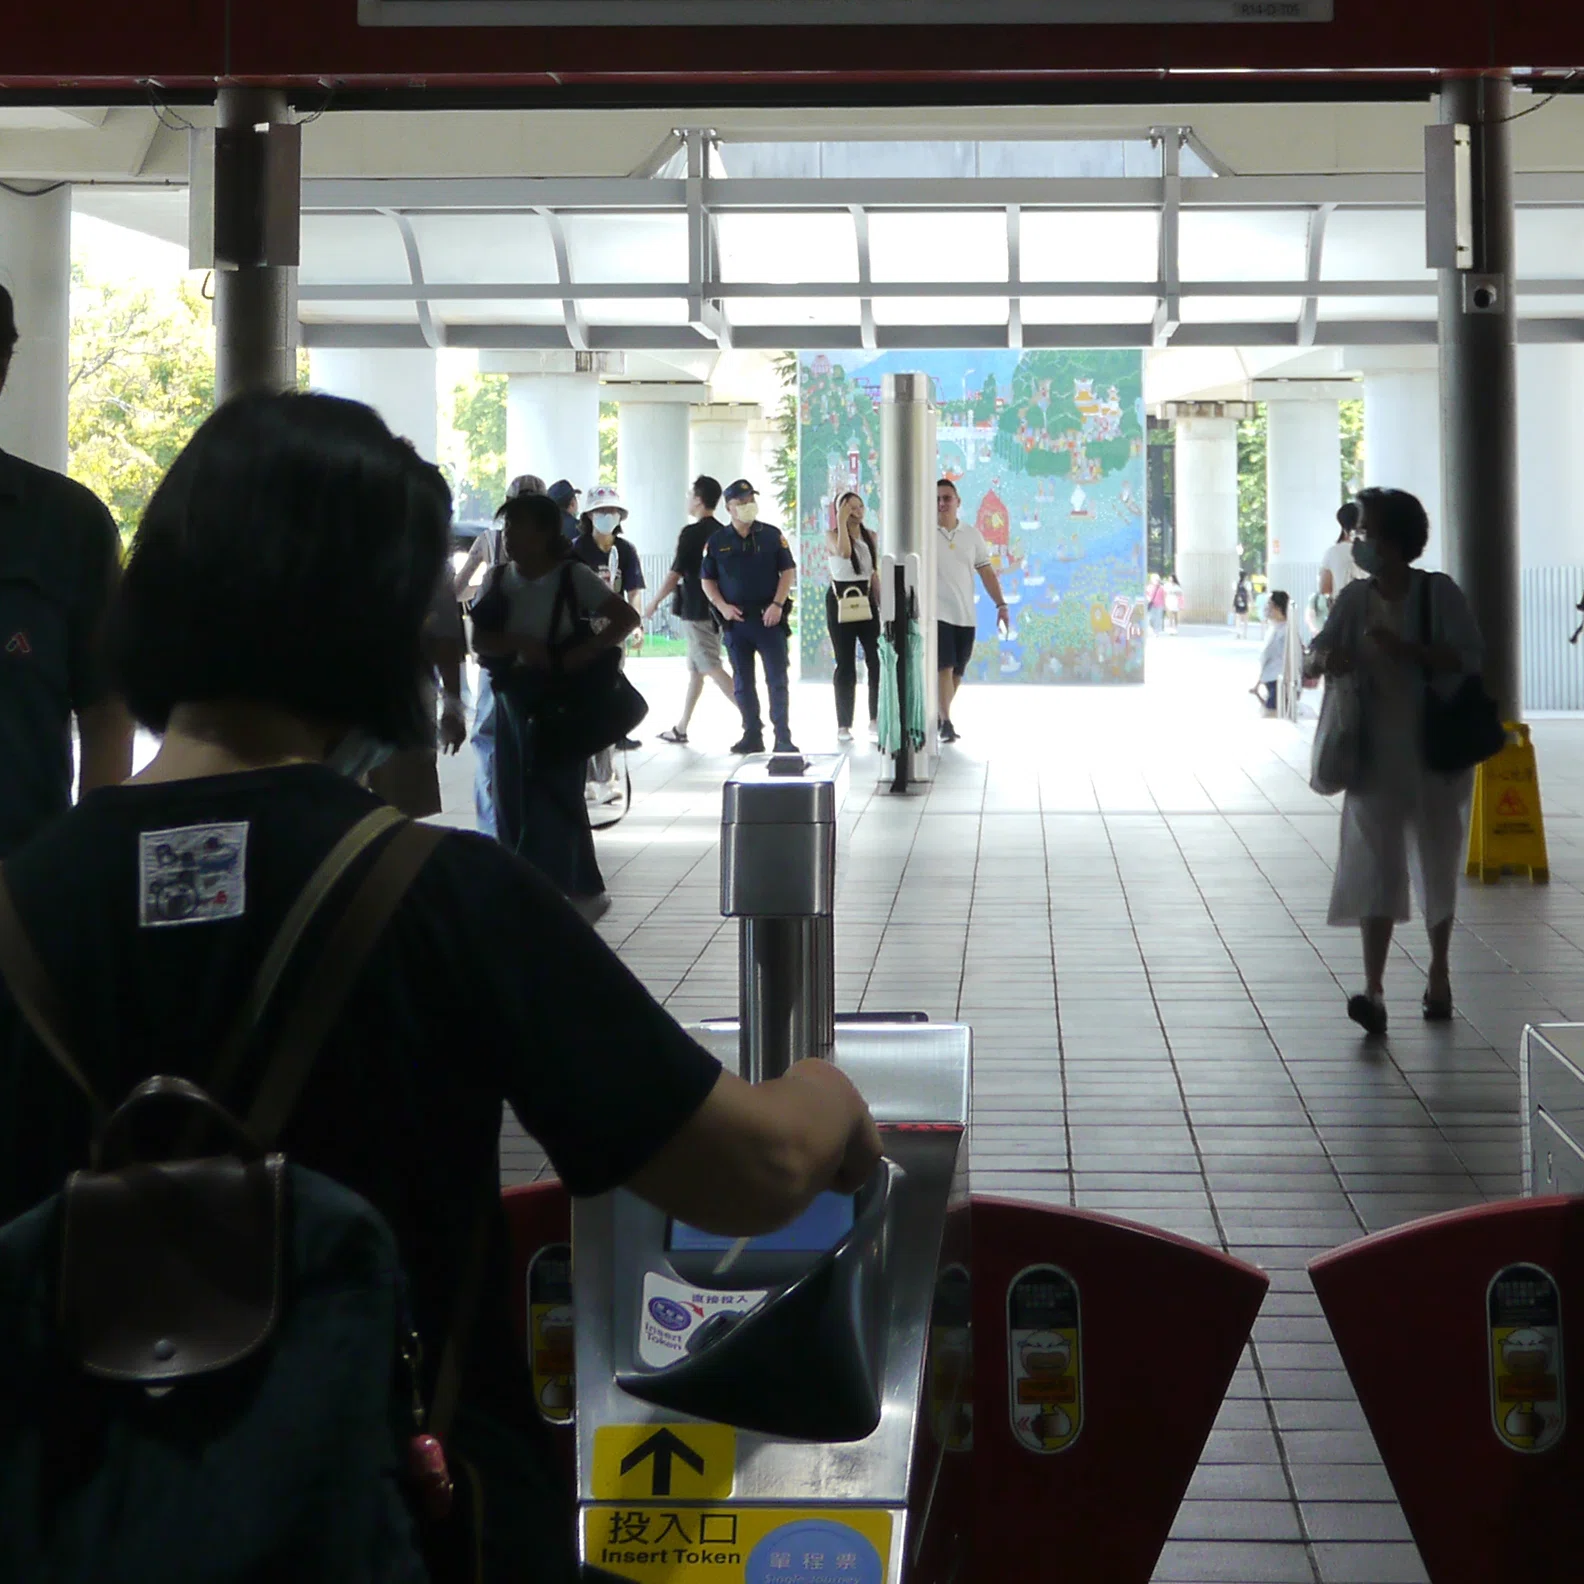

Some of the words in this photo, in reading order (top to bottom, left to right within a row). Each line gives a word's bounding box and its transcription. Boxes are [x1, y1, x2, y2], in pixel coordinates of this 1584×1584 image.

[692, 1293, 749, 1305] 直接投入
[645, 1321, 683, 1343] Insert
[646, 1333, 683, 1351] Token
[608, 1510, 738, 1545] 投入口
[601, 1547, 670, 1565] Insert
[673, 1547, 741, 1565] Token
[769, 1551, 858, 1571] 單程票
